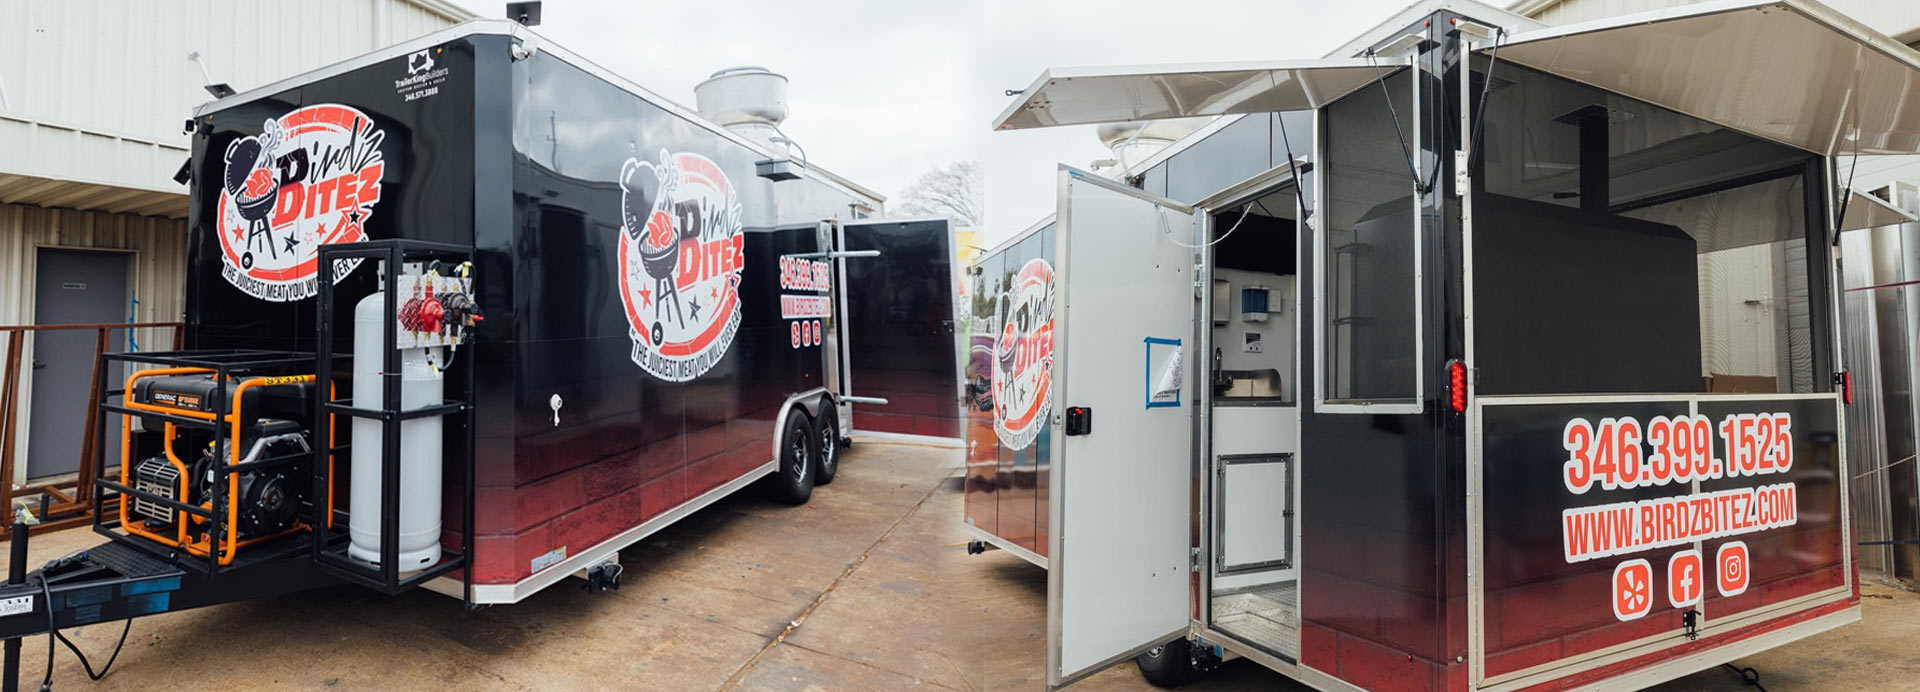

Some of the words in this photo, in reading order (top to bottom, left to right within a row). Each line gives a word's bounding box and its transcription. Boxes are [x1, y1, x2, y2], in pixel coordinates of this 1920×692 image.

[236, 272, 265, 298] JUICIEST
[266, 284, 286, 299] MEAT
[287, 280, 304, 298] YOU
[333, 257, 351, 280] VER
[678, 359, 695, 378] MEAT
[695, 351, 709, 375] YOU
[1568, 417, 1790, 488] 346.399.1525
[1566, 487, 1794, 557] WWW.BIRDZBITEZ.COM
